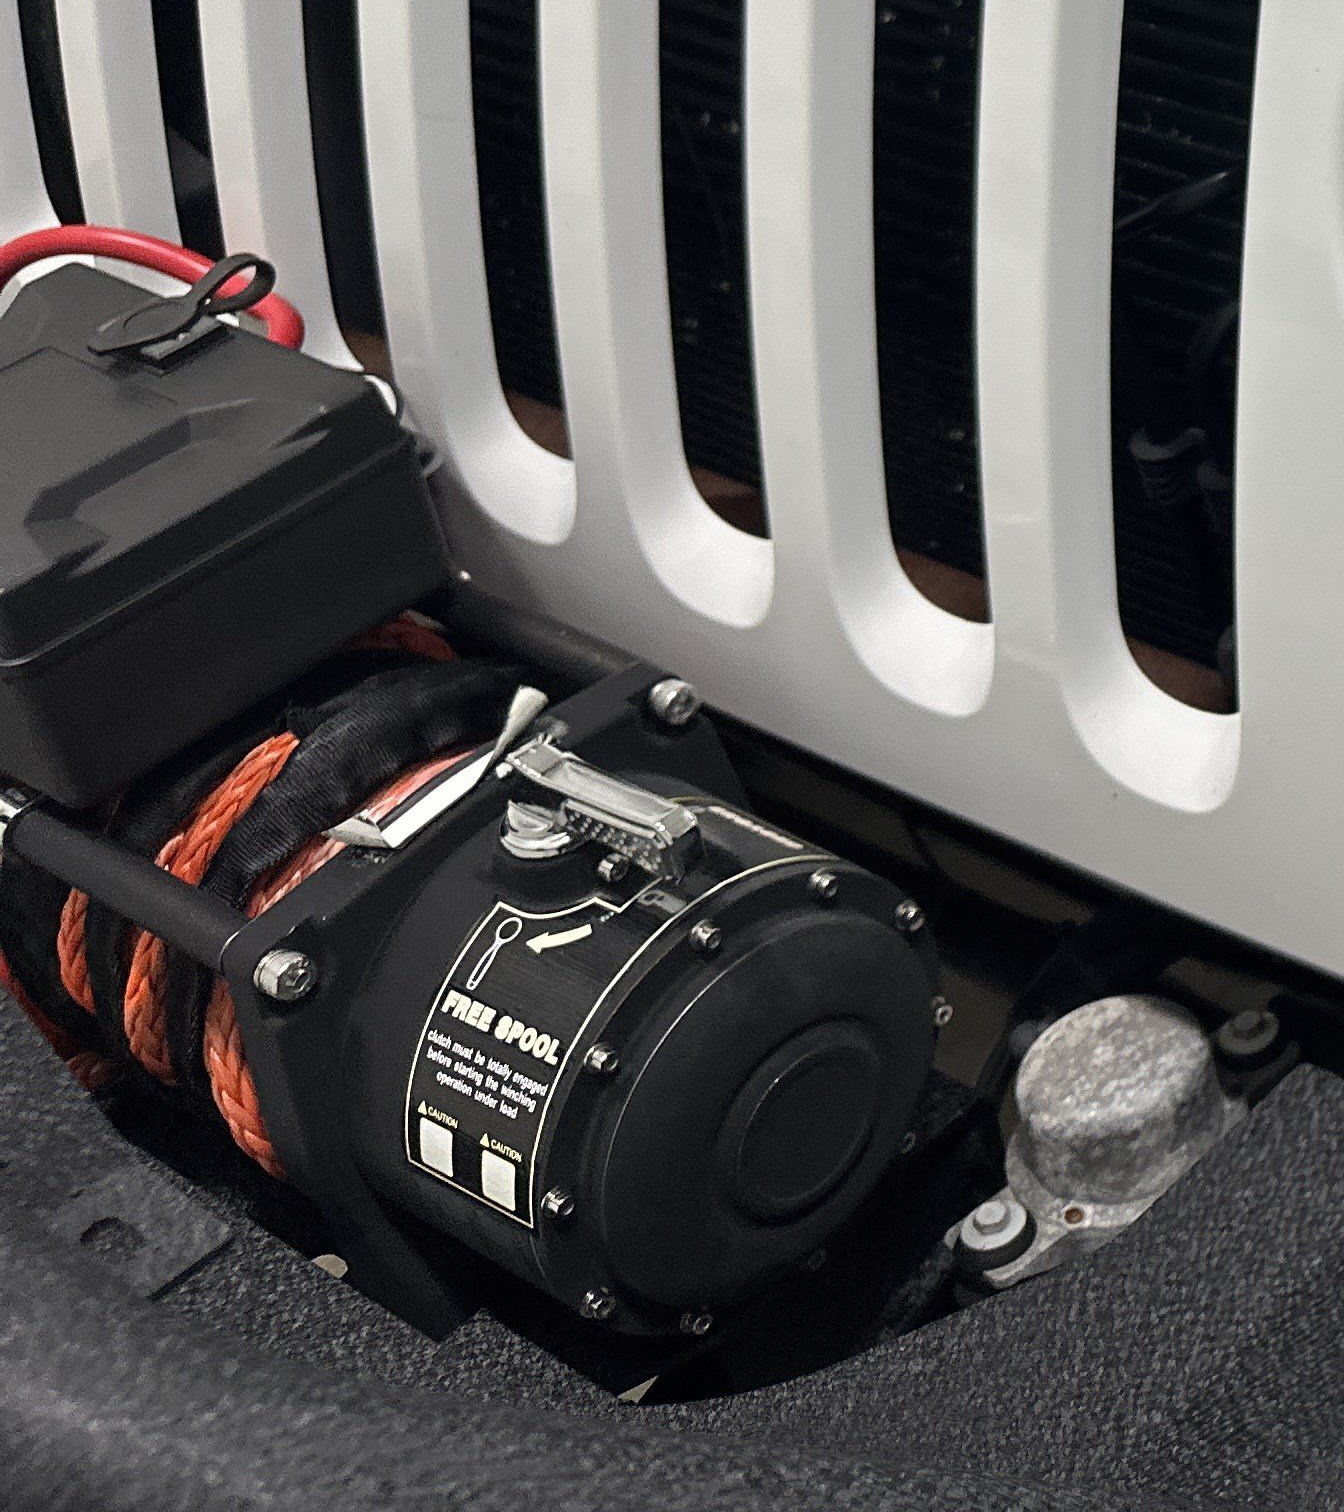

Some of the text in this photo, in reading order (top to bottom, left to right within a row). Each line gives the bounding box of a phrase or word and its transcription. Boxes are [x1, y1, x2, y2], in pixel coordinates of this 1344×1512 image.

[441, 989, 560, 1066] FREE SPOOL
[427, 1029, 549, 1097] clutch must be totally engaged
[427, 1046, 537, 1113] before starting the winching
[427, 1106, 459, 1129] CAUTION
[436, 1071, 519, 1119] operation under load
[490, 1139, 523, 1163] CAUTION
